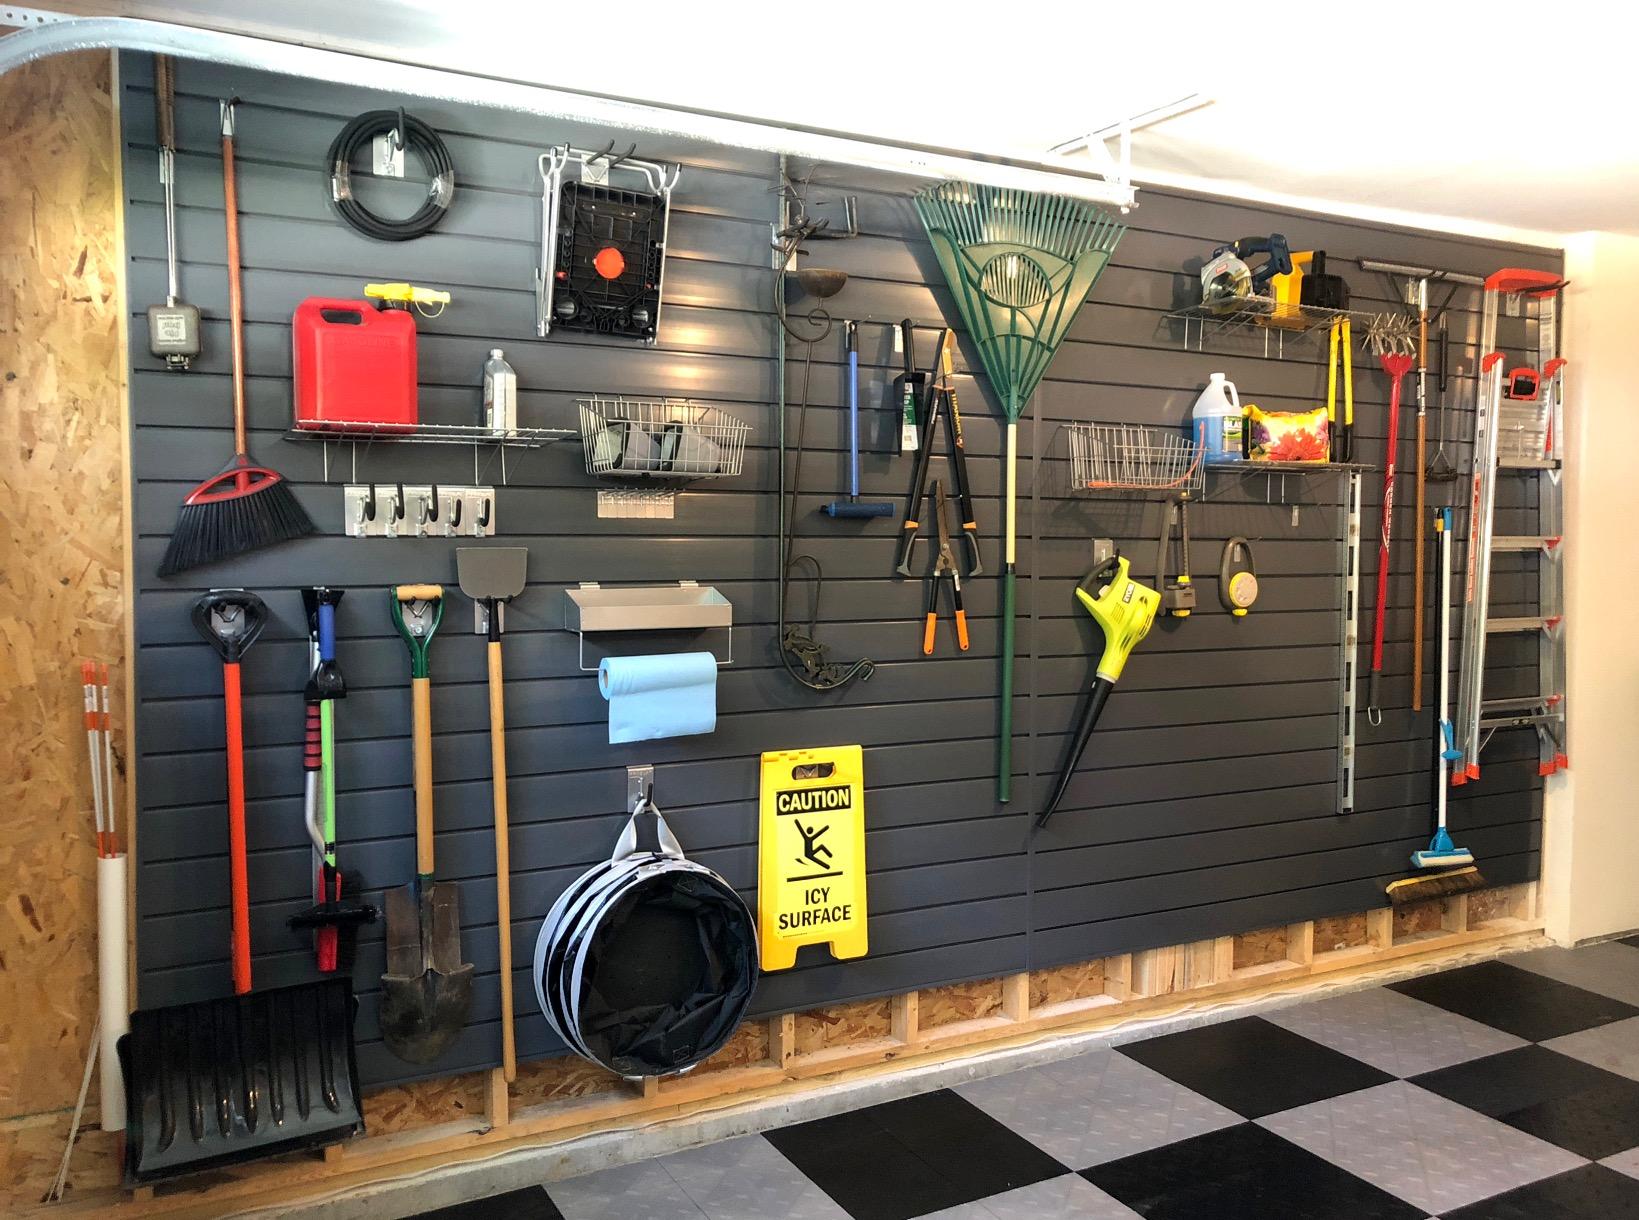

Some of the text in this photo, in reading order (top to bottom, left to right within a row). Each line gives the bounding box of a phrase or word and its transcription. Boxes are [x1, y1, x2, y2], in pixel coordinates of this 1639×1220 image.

[778, 788, 850, 813] CAUTION
[805, 887, 830, 905] ICY
[778, 905, 851, 930] SURFACE
